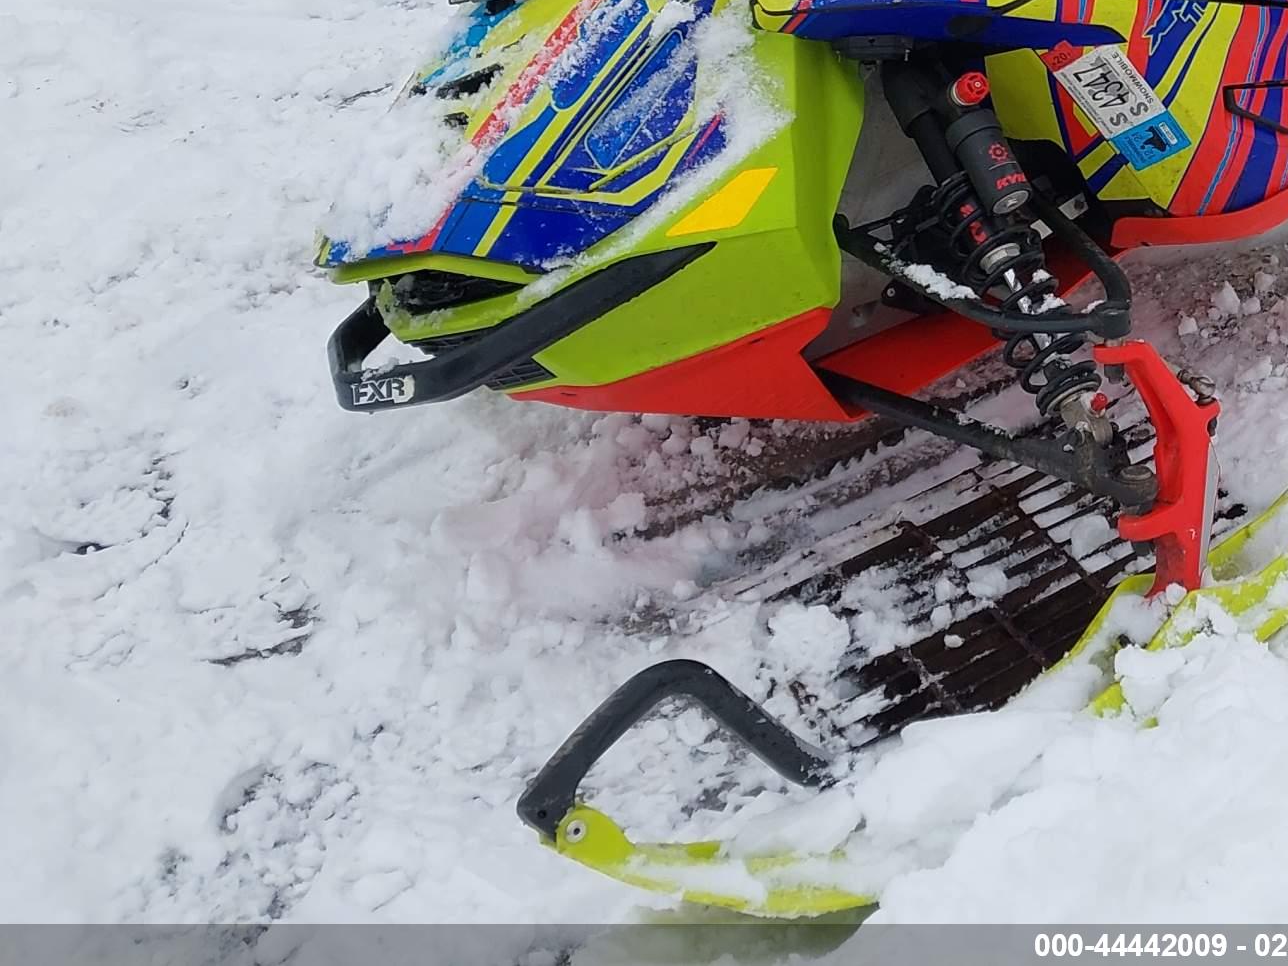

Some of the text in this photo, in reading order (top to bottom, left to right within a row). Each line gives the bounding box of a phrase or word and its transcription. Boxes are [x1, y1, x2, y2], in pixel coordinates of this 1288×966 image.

[1072, 62, 1130, 109] 4347
[1111, 51, 1154, 104] SNOWMOBILE
[351, 377, 411, 406] FXR
